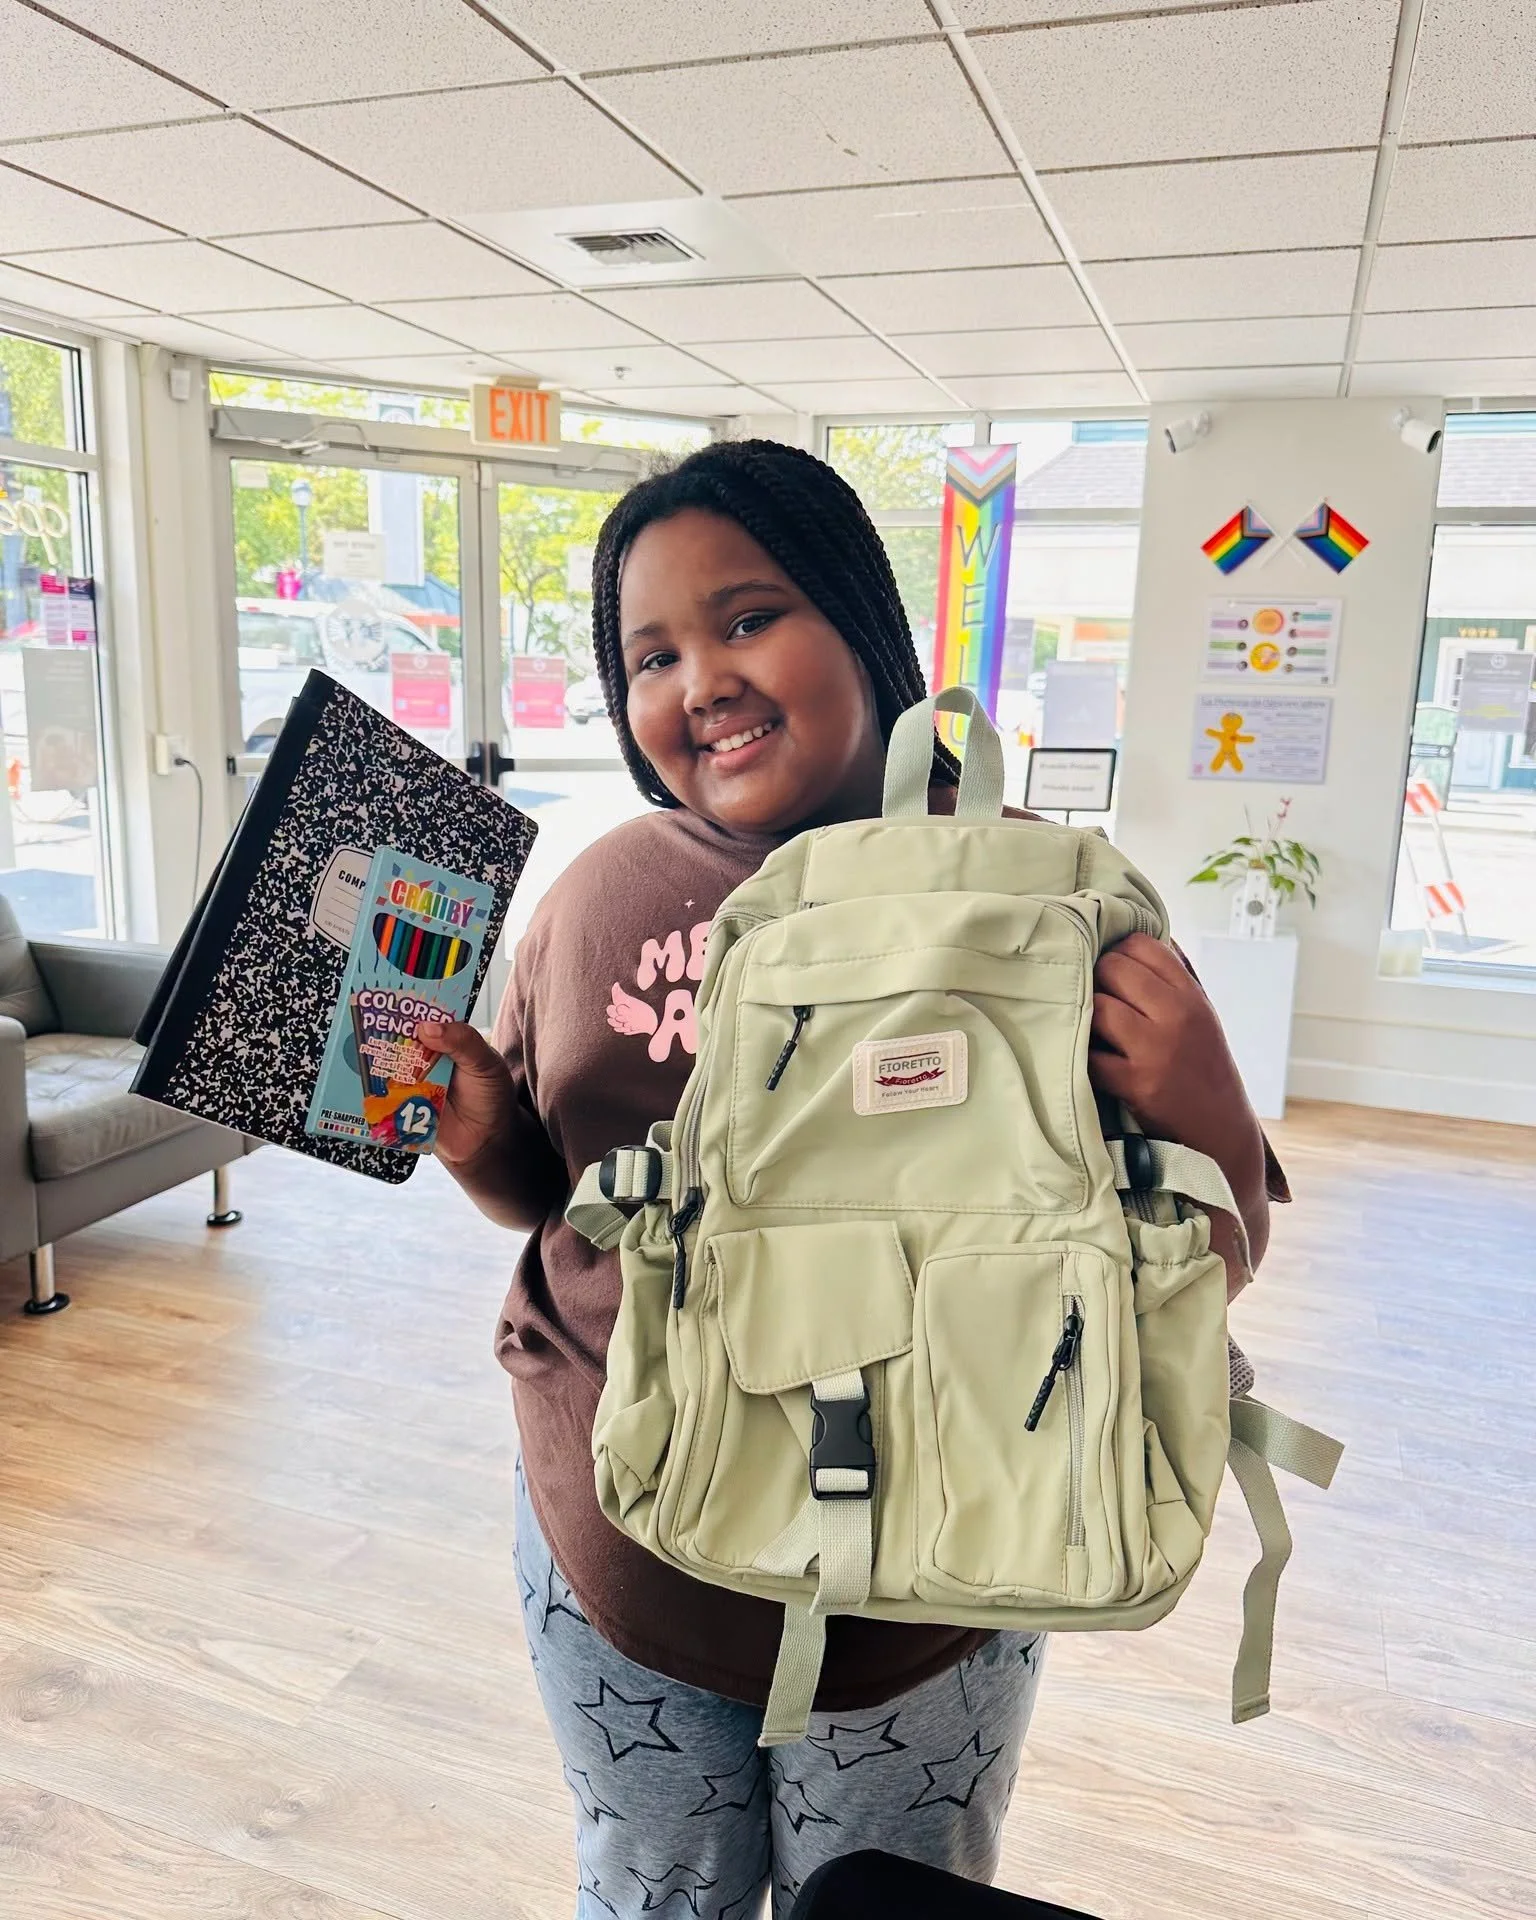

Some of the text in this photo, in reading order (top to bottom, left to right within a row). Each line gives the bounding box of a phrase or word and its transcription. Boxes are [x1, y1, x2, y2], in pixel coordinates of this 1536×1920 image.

[488, 386, 549, 444] EXIT
[360, 1044, 398, 1061] Premium
[373, 1057, 414, 1074] Certified
[878, 1056, 942, 1074] FIORETTO
[894, 1074, 928, 1085] Fioretto
[904, 1087, 919, 1095] Your
[920, 1085, 939, 1093] Heart
[320, 1108, 366, 1126] PRE-SHARPENED
[400, 1102, 432, 1135] 12
